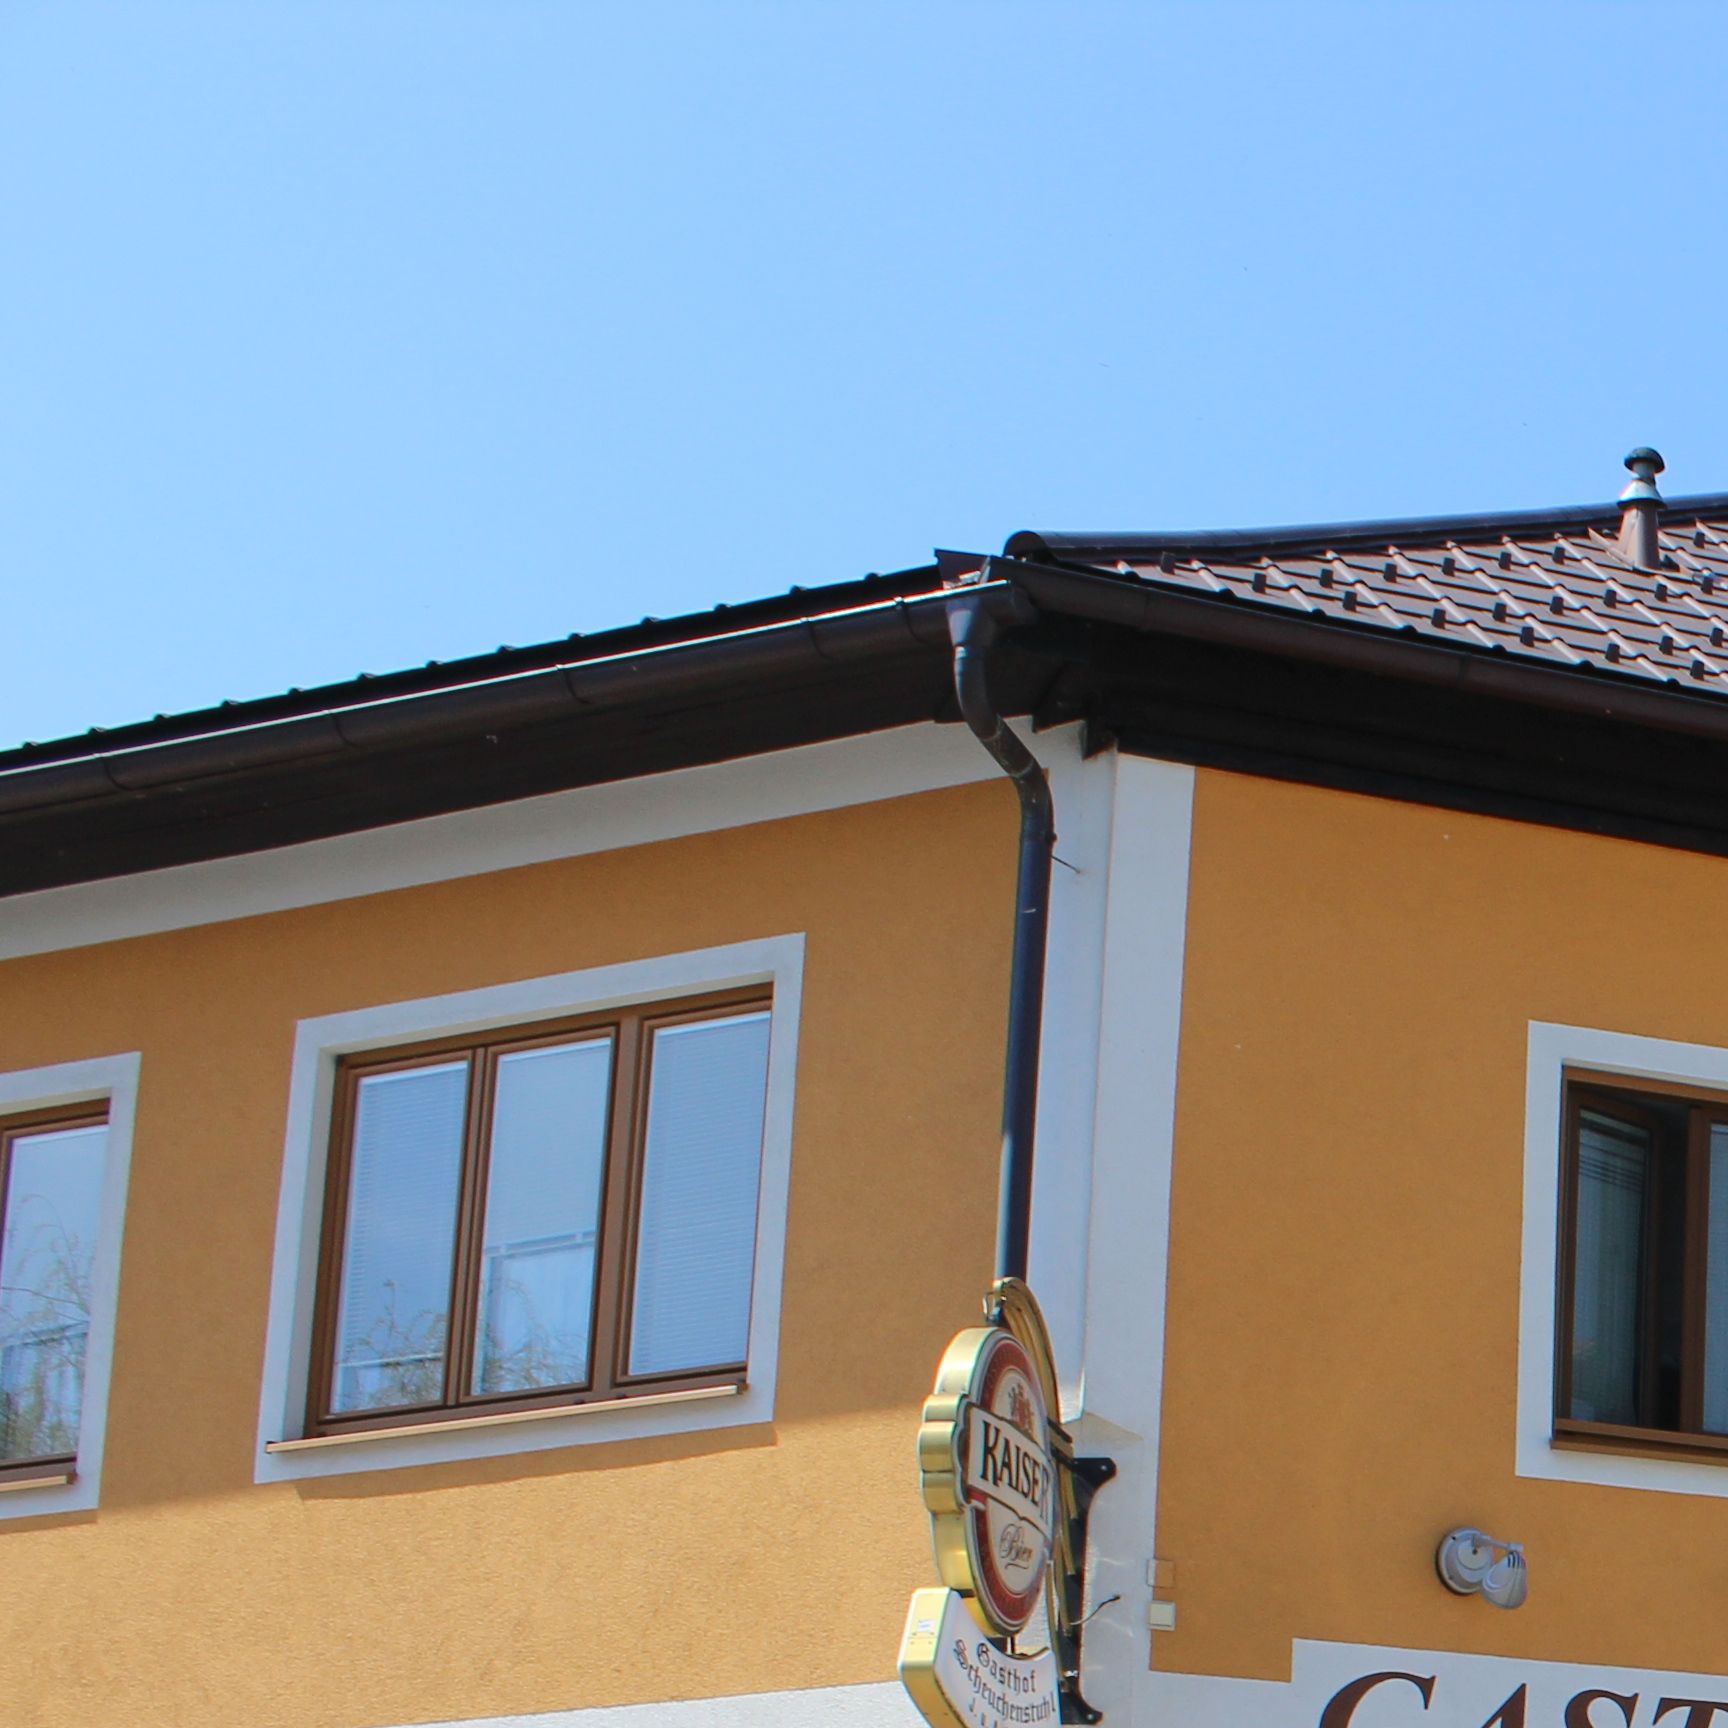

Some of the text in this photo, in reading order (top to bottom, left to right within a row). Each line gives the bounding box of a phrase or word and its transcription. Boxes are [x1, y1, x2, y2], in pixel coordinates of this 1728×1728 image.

[980, 1419, 1051, 1526] KAISER
[1000, 1523, 1034, 1563] Bier
[953, 1639, 1057, 1723] Scheuchenstuhl
[976, 1642, 1036, 1696] Gasthof
